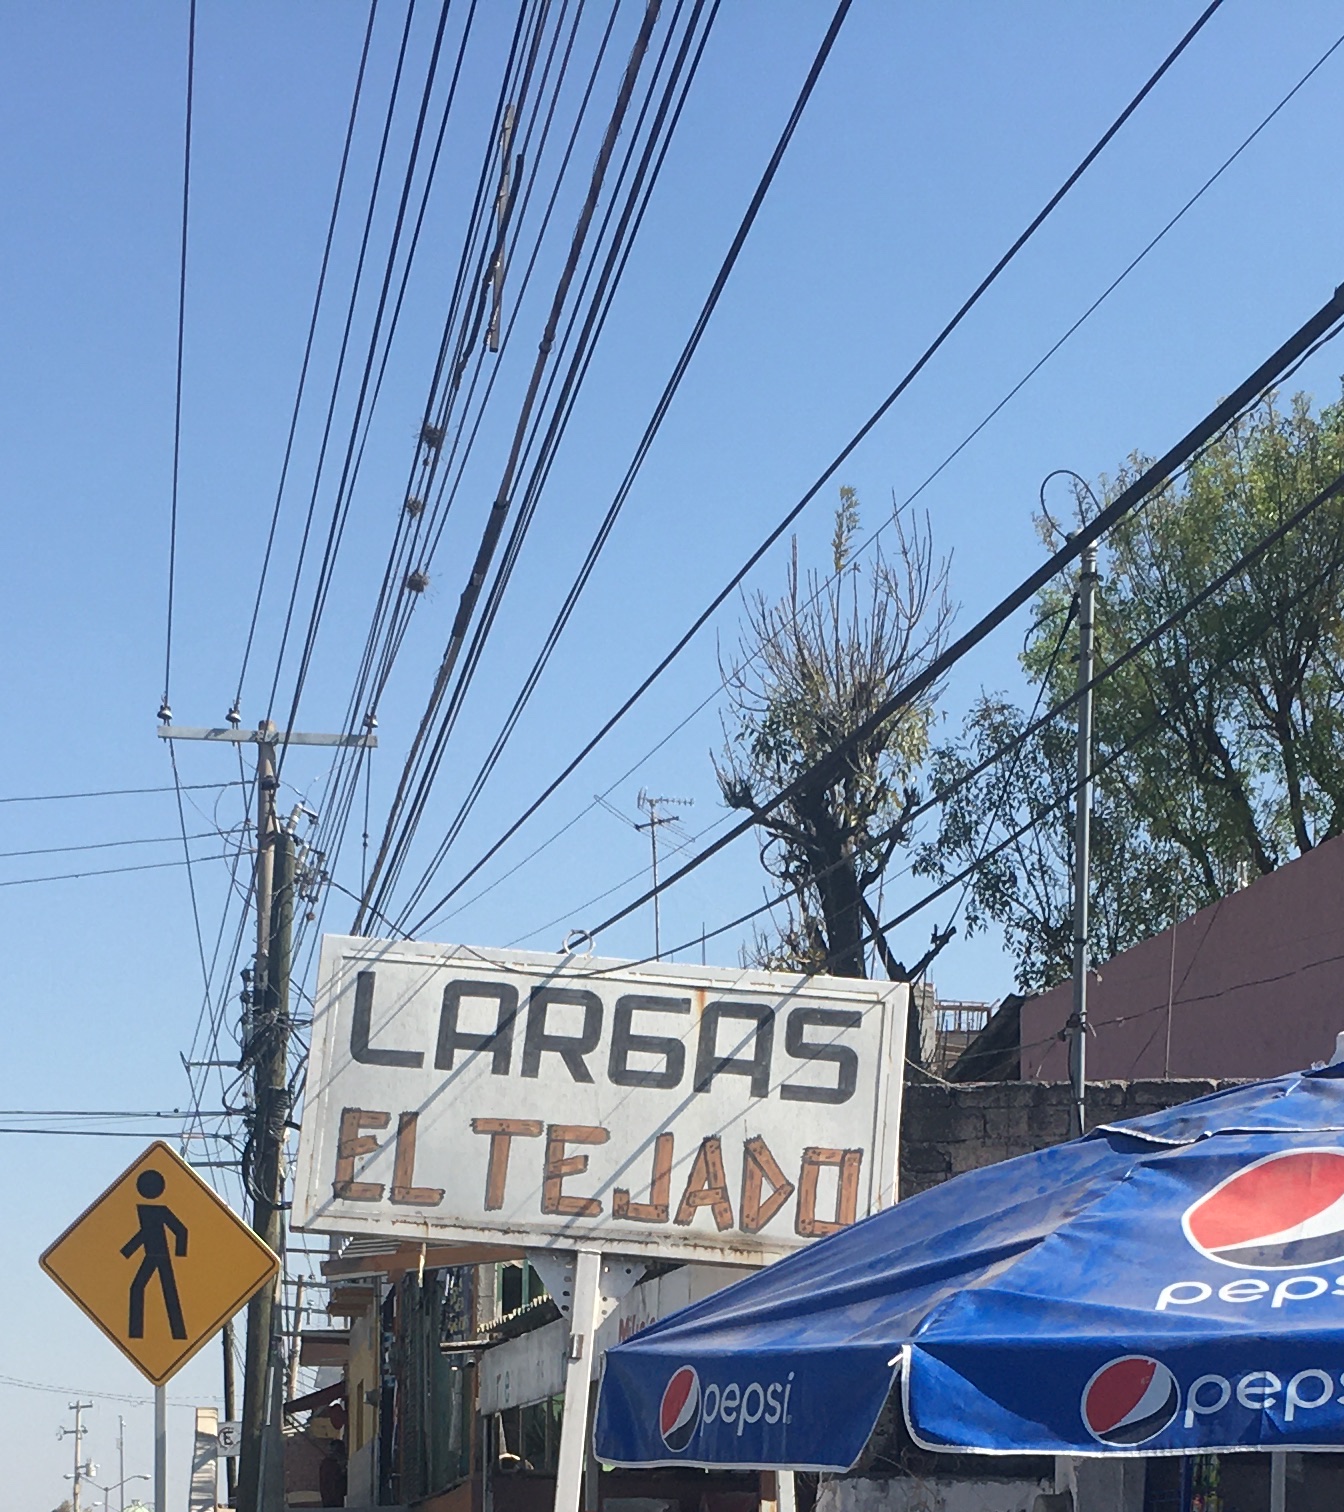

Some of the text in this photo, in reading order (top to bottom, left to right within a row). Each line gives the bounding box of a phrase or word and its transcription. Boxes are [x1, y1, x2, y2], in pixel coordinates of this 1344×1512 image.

[332, 1107, 864, 1238] EL TEJADO
[700, 1371, 795, 1437] pepsi
